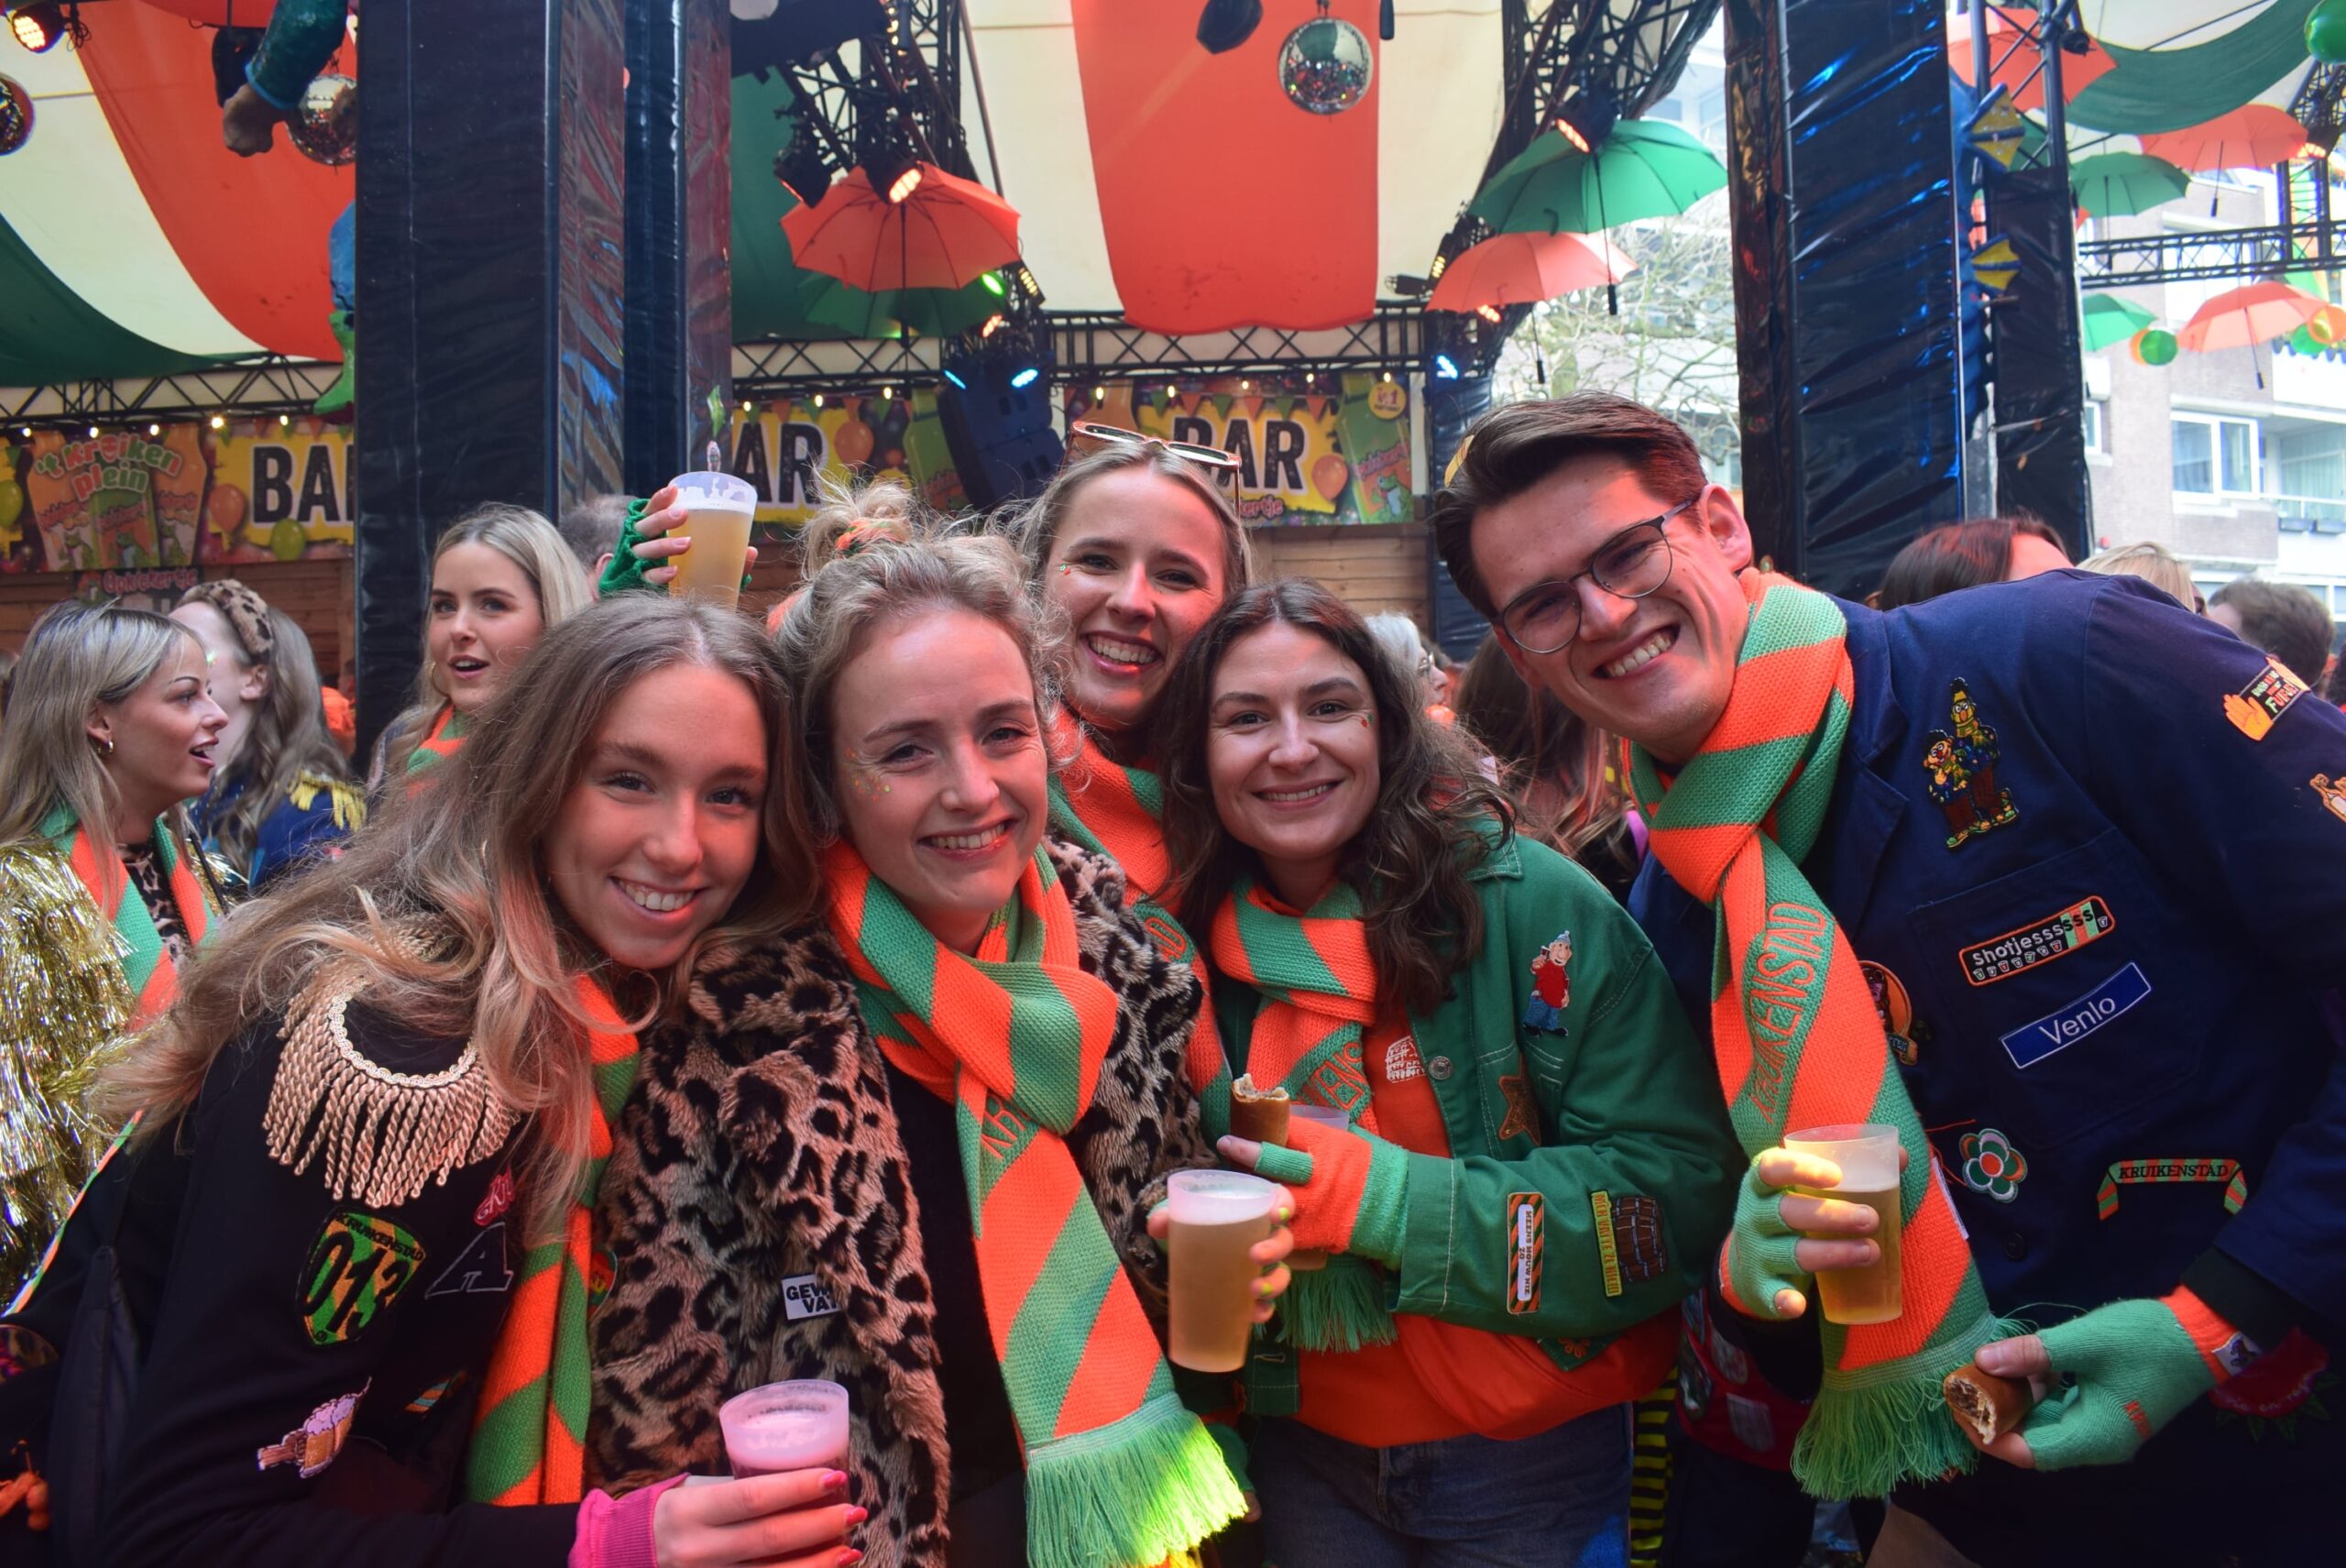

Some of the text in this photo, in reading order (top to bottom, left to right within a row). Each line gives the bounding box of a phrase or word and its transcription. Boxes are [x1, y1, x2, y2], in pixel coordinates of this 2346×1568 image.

[71, 460, 150, 502] plein
[253, 444, 356, 524] BA
[732, 421, 830, 505] AR
[2037, 996, 2116, 1045] Venlo
[2118, 1164, 2229, 1180] KRUIKENSTAD
[304, 1231, 412, 1341] 013
[785, 1282, 830, 1301] GEW
